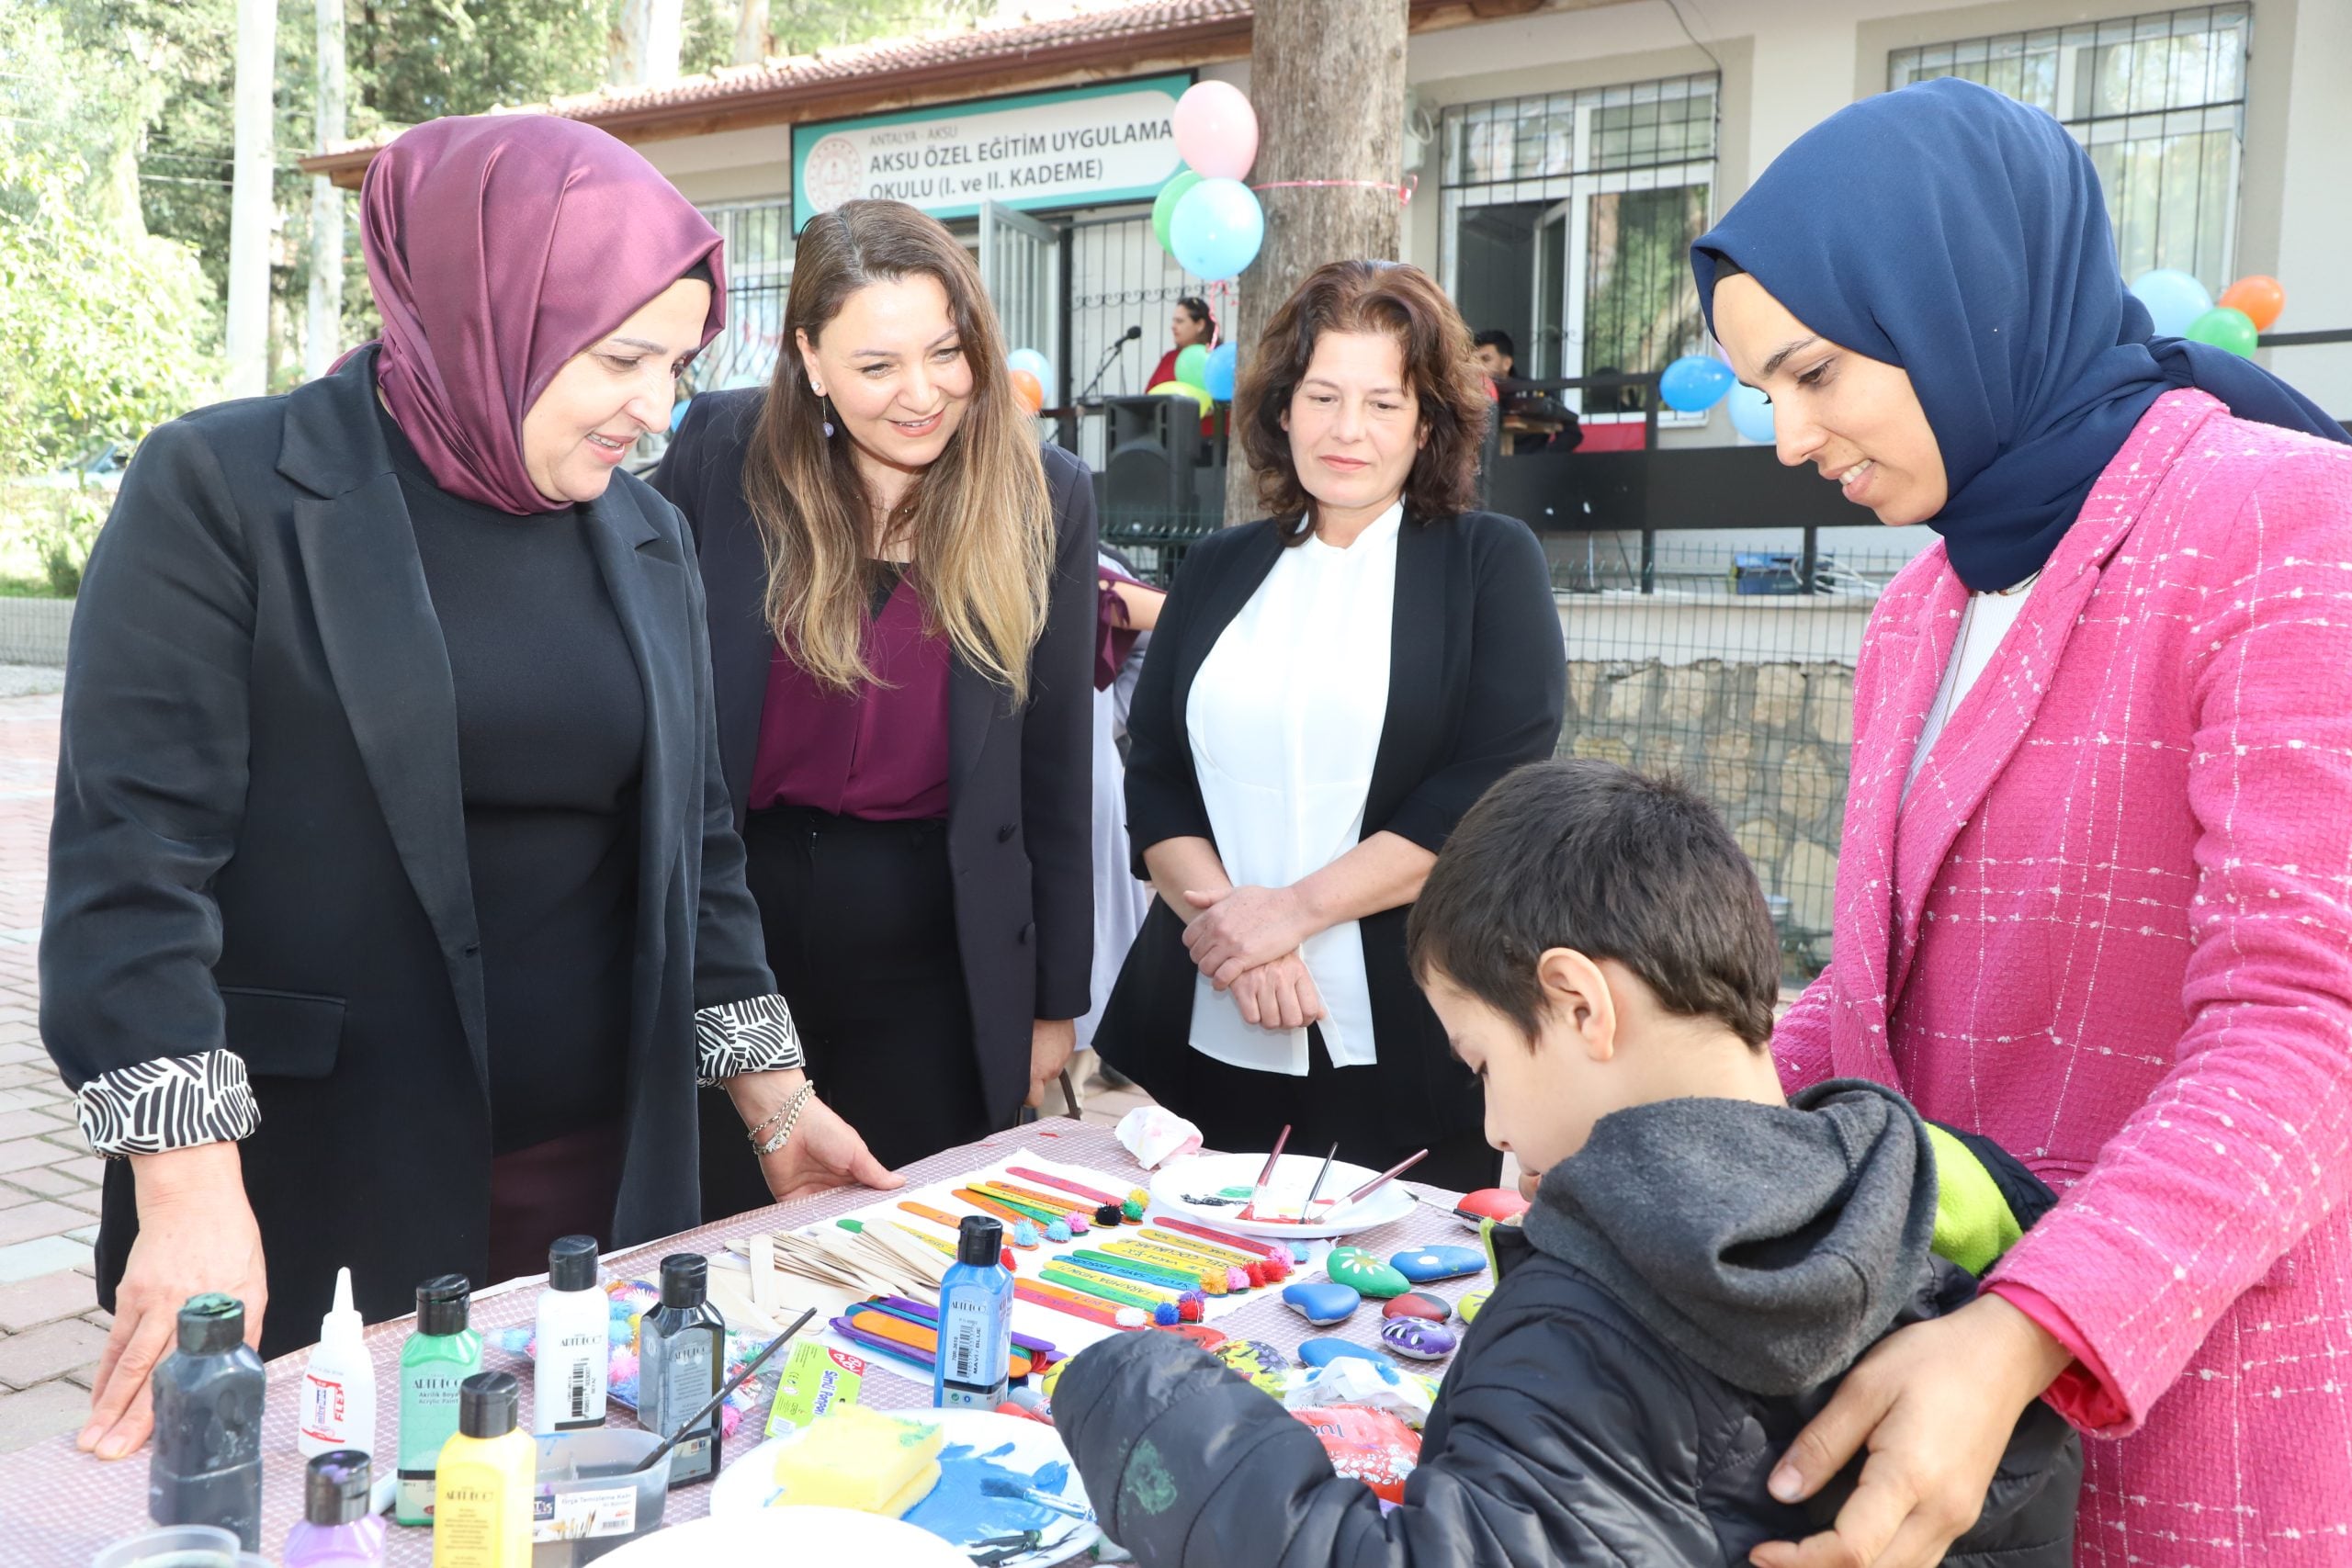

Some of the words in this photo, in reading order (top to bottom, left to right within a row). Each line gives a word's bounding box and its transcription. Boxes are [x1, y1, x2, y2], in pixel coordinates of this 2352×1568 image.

[869, 130, 917, 147] ANTALYA
[927, 126, 958, 140] AKSU
[869, 151, 920, 174] AKSU
[924, 145, 971, 168] ÖZEL
[978, 133, 1046, 162] EĞİTİM
[1052, 119, 1173, 152] UYGULAMA
[869, 178, 933, 199] OKULU
[961, 177, 982, 192] ve
[1011, 158, 1103, 187] KADEME)
[334, 1386, 345, 1422] FLEX
